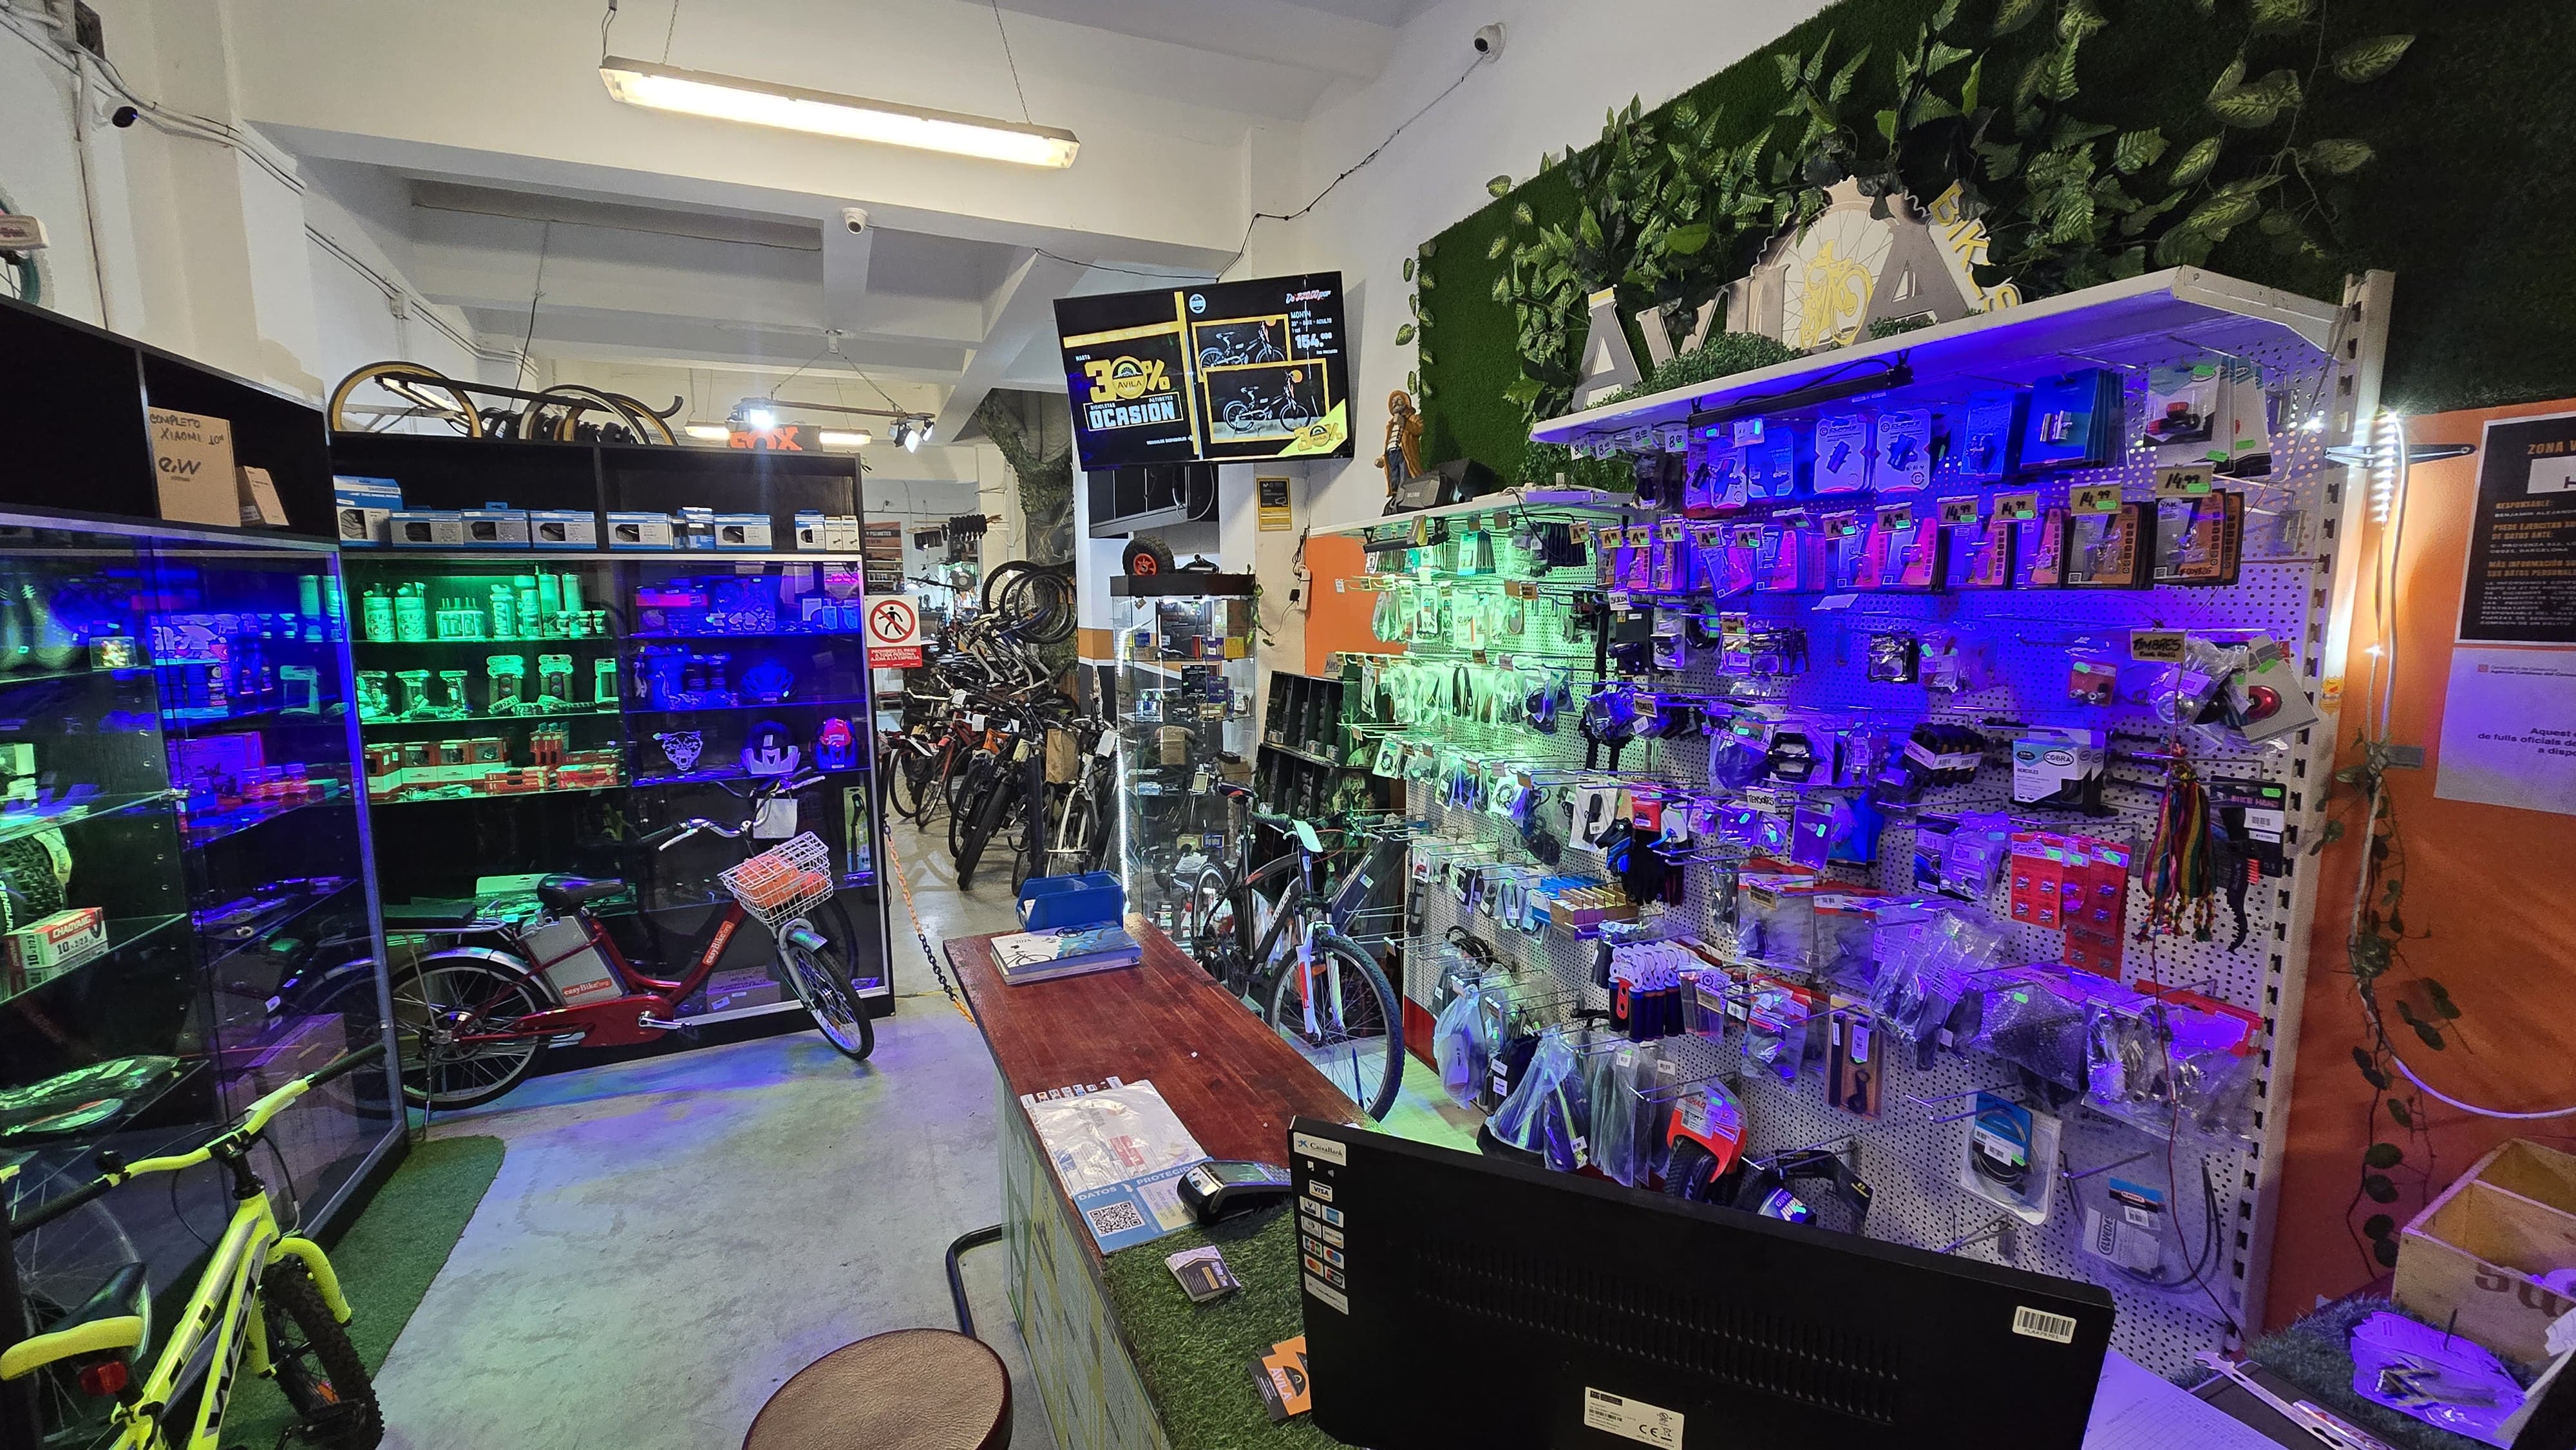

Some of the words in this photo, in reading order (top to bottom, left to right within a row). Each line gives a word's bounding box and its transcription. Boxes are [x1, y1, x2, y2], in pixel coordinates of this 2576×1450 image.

[1117, 379, 1143, 390] AVILA
[149, 413, 201, 429] COMPLETO
[1090, 401, 1175, 429] OCASION
[160, 428, 202, 443] XIAOMI
[2527, 441, 2564, 455] ZONA
[493, 601, 509, 635] MP70
[2133, 637, 2181, 652] TIMBRES
[2494, 733, 2517, 742] fulls
[2521, 736, 2561, 746] oficials
[2530, 728, 2571, 737] Aquest
[1748, 794, 1774, 805] TENSORES
[52, 914, 91, 939] CHAOYANG
[57, 941, 70, 956] 10
[1310, 1142, 1343, 1156] CaixaBank
[1078, 1187, 1117, 1201] DATOS
[1314, 1186, 1329, 1196] VISA
